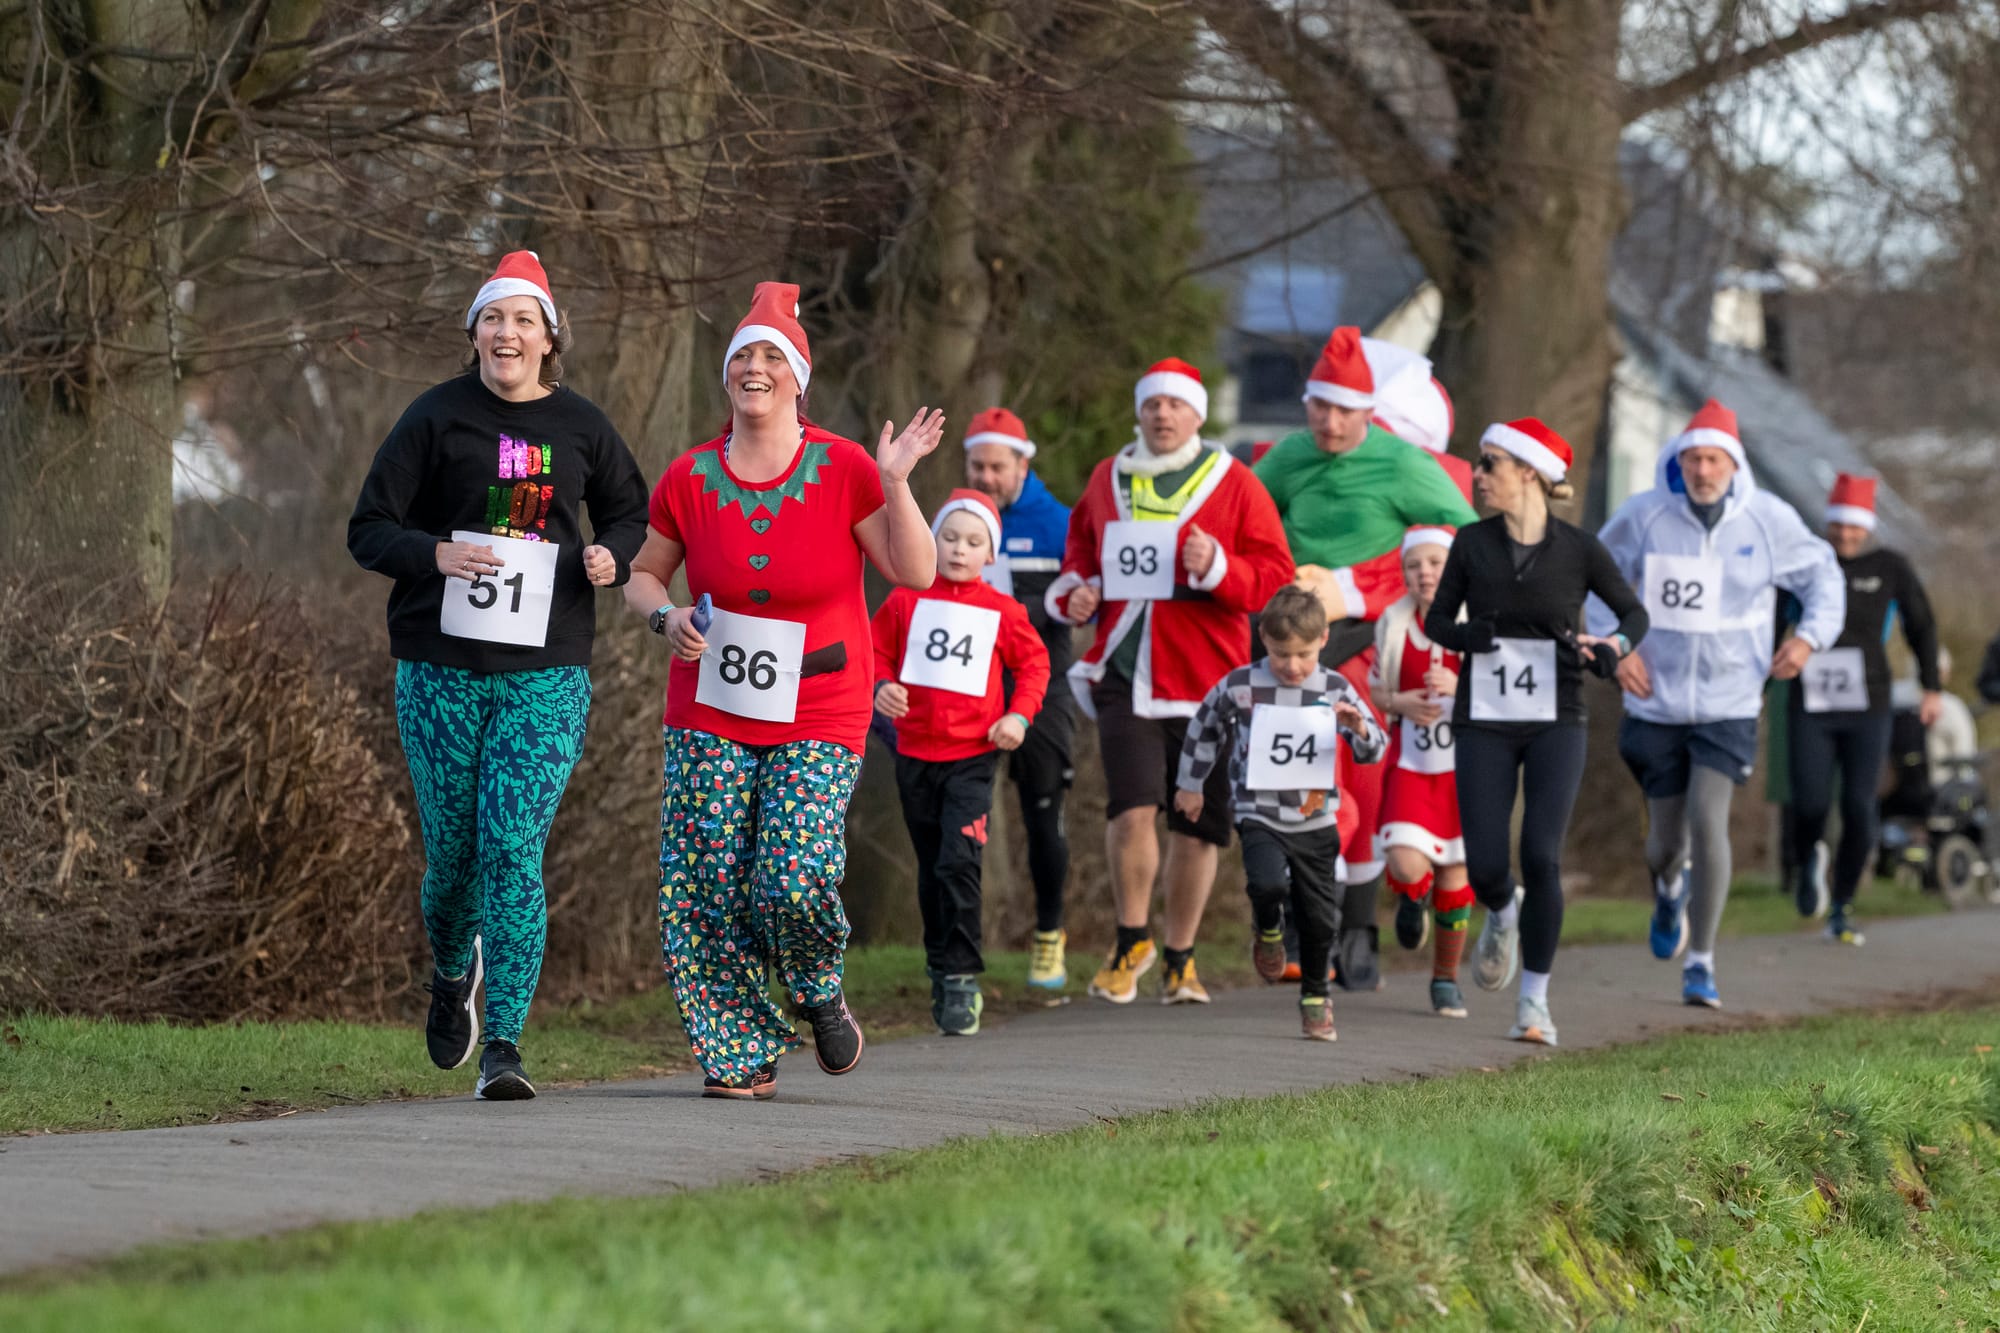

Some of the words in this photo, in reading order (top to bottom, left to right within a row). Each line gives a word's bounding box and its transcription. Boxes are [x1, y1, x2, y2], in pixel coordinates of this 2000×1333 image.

[486, 482, 554, 529] HO!
[1119, 546, 1159, 576] 93
[468, 570, 524, 613] 51
[1661, 580, 1704, 610] 82
[925, 628, 973, 667] 84
[719, 644, 778, 690] 86
[1492, 664, 1537, 696] 14
[1818, 667, 1851, 693] 72
[1269, 733, 1318, 764] 54
[1414, 721, 1455, 751] 30
